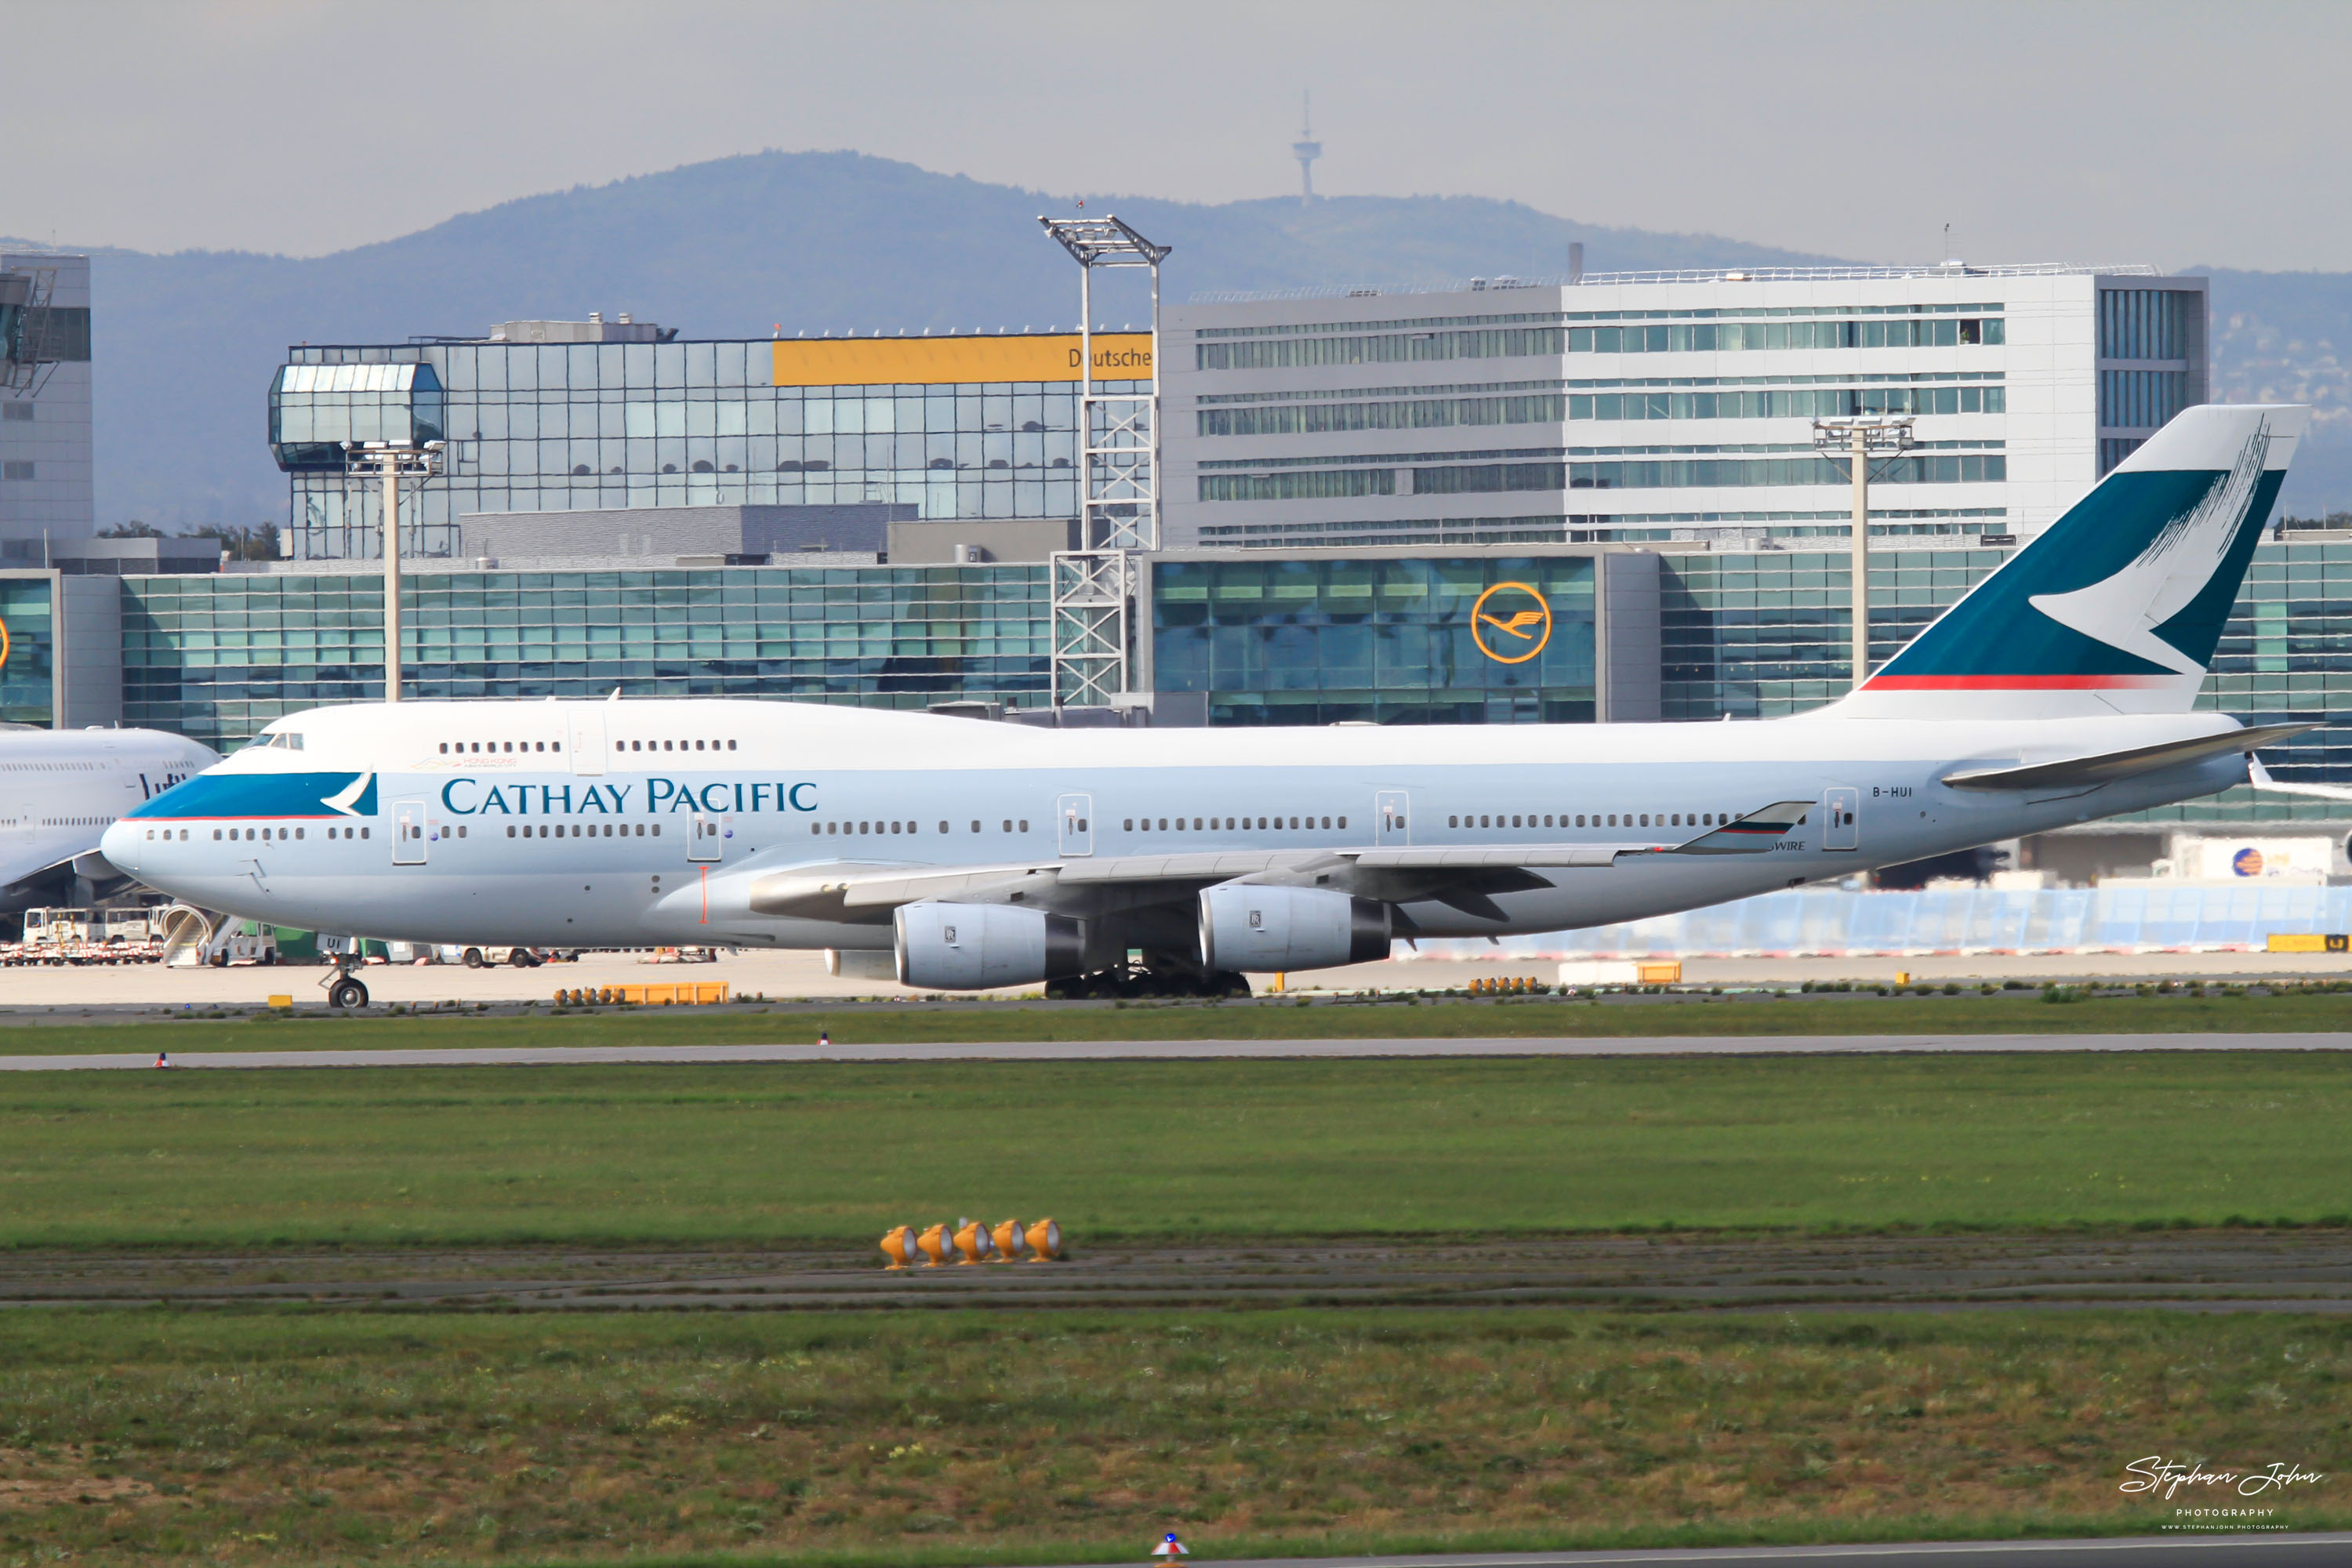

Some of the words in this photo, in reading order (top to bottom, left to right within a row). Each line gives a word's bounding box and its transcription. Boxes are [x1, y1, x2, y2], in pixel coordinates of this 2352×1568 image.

[1069, 348, 1152, 368] Dutsche
[441, 778, 632, 815] CATHAY
[646, 778, 818, 813] PACIFIC
[1873, 786, 1911, 797] B-HUI
